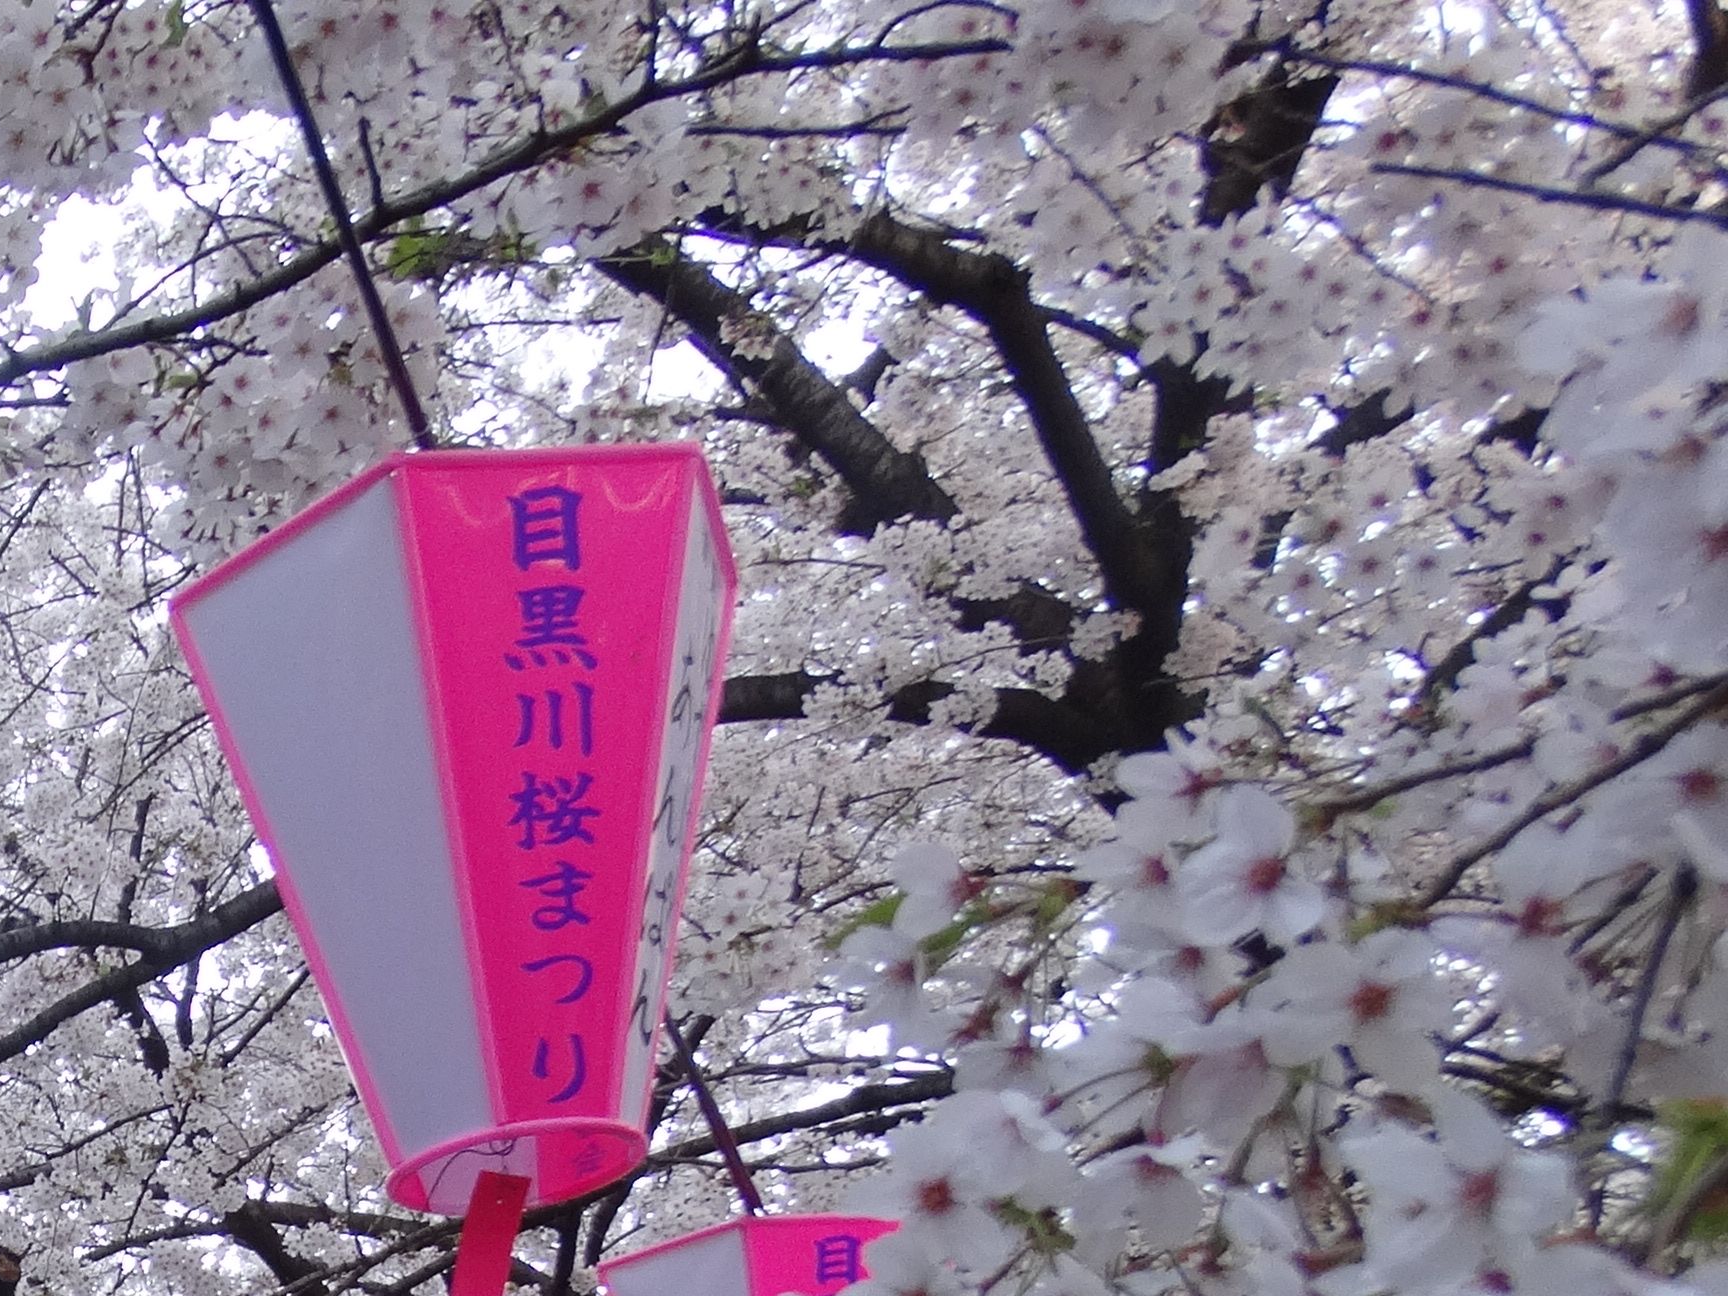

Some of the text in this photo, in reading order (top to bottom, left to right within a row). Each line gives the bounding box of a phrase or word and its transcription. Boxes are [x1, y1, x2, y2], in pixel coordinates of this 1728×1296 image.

[503, 484, 601, 1104] 目黒川桜まつり
